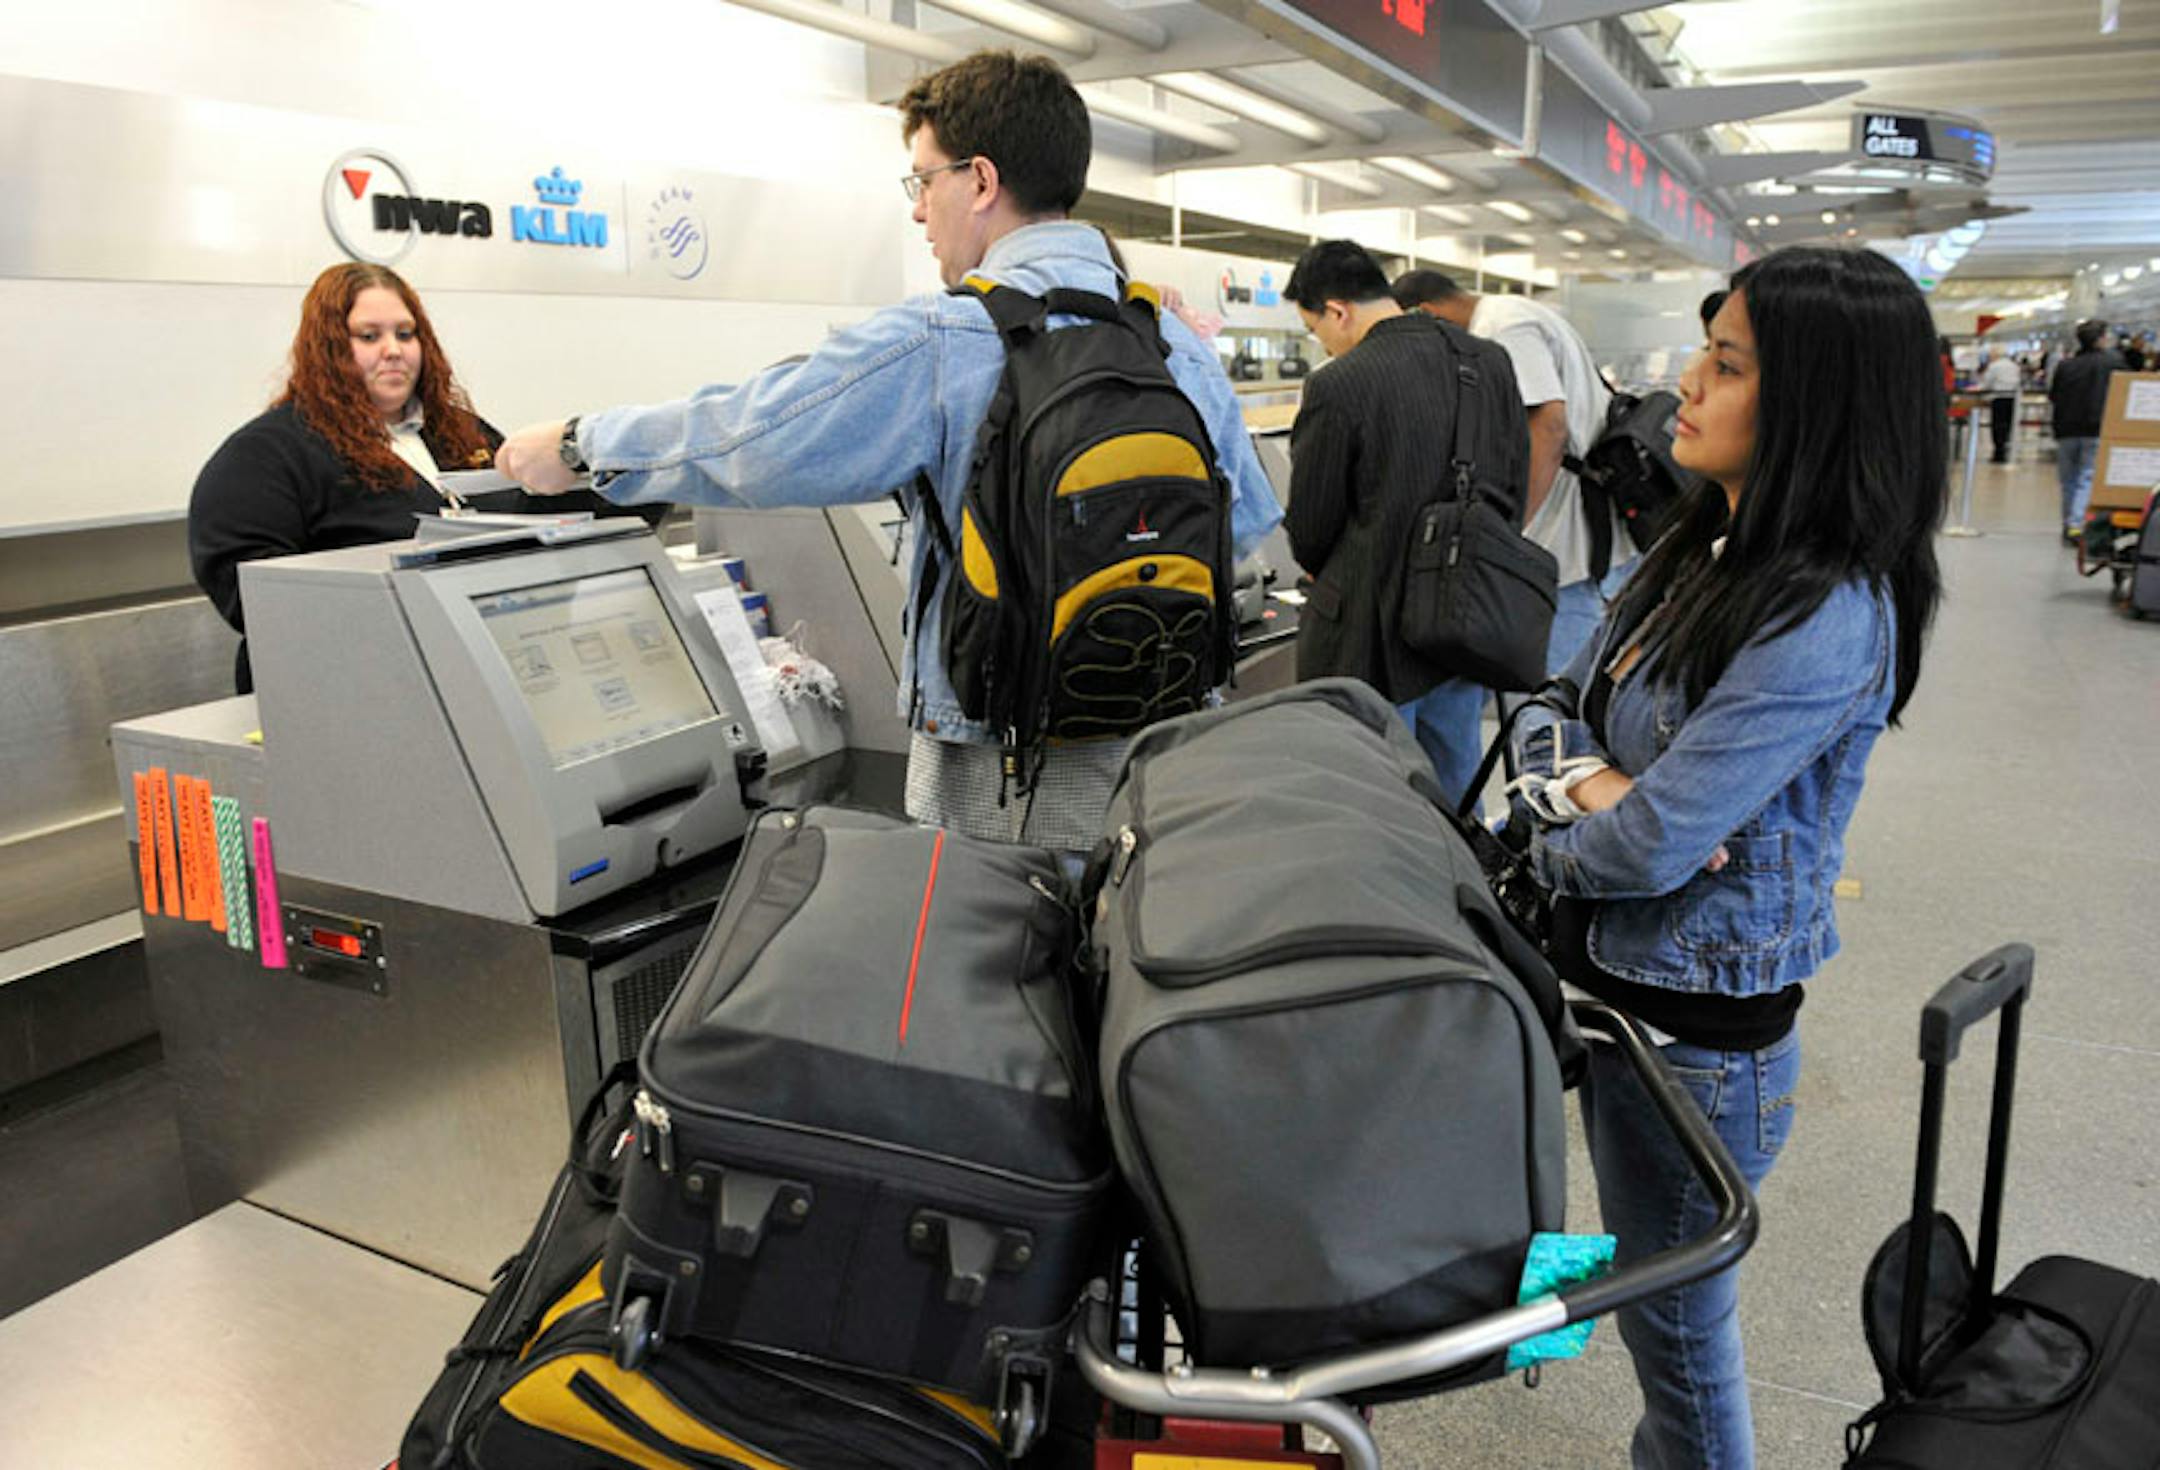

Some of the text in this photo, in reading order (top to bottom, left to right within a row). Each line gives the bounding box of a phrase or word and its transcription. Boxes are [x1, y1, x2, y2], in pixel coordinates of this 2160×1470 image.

[1867, 116, 1899, 136] ALL
[1865, 135, 1919, 157] GATES
[372, 193, 493, 239] nwa
[510, 205, 607, 248] KLM
